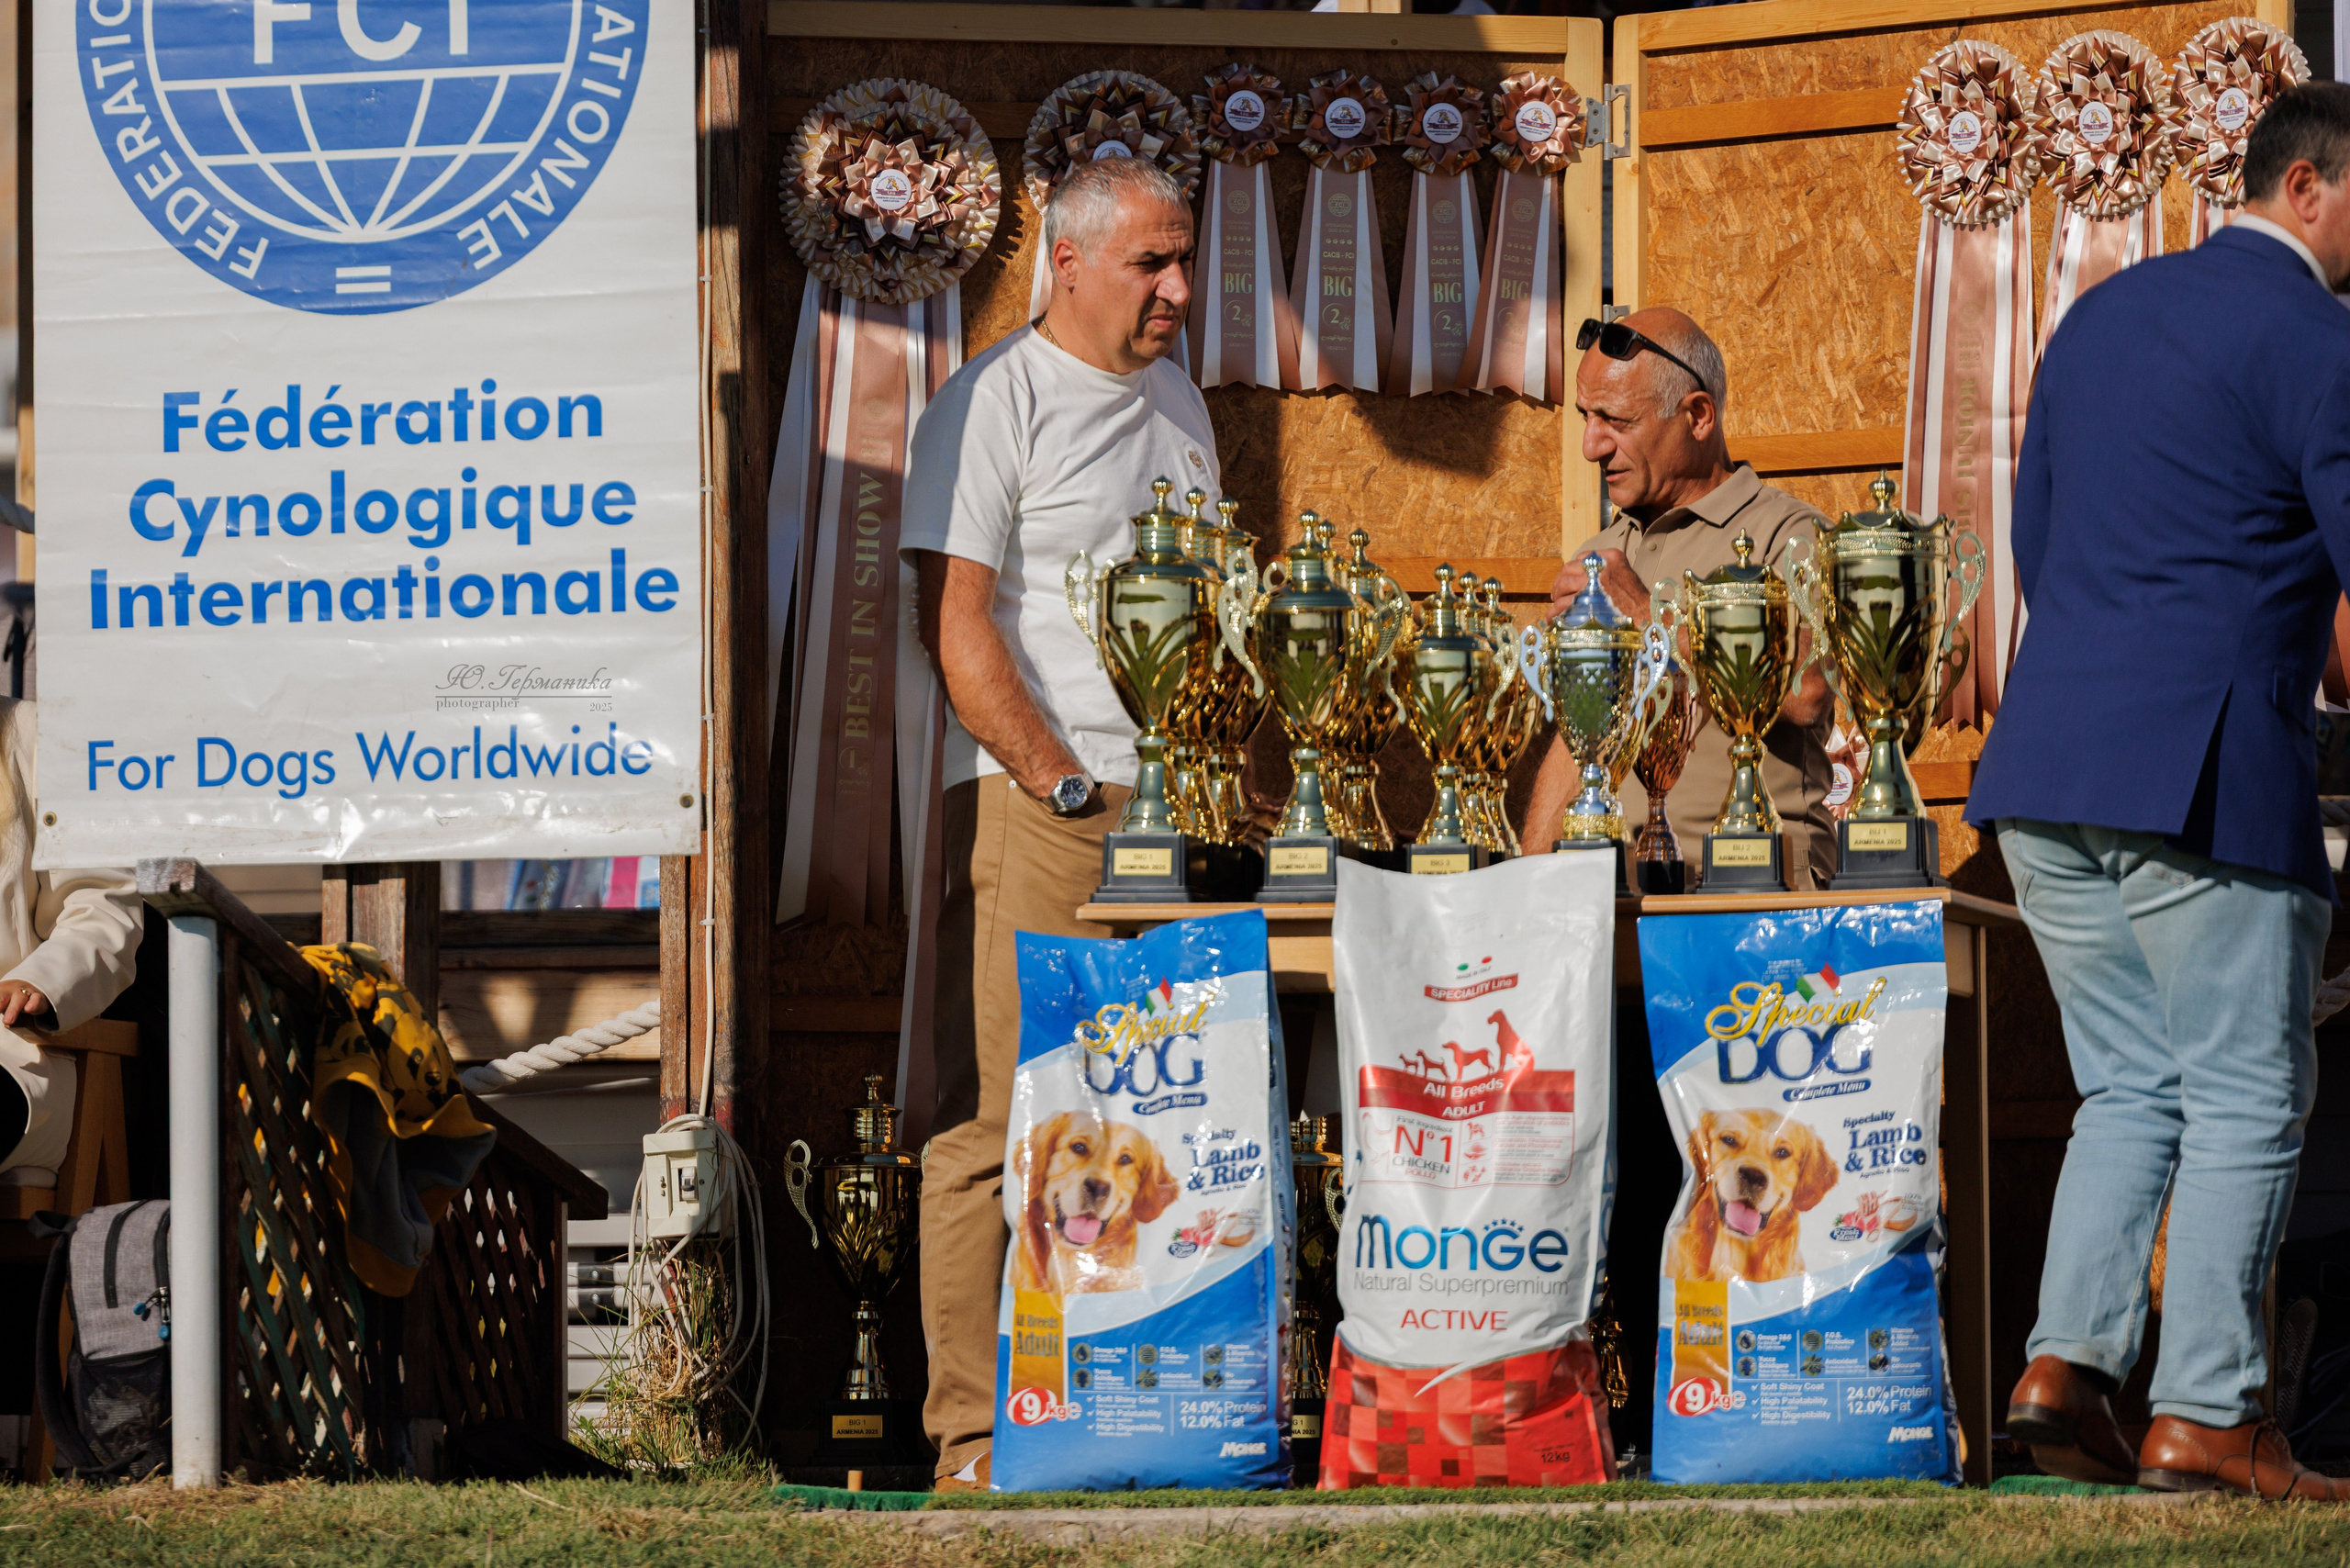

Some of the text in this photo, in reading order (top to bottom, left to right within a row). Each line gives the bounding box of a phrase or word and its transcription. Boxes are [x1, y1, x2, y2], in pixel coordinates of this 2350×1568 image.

[1323, 251, 1340, 259] CACIB
[1225, 273, 1253, 294] BIG
[1323, 275, 1352, 297] BIG
[1433, 282, 1462, 303] BIG
[1500, 278, 1529, 302] BIG
[1232, 306, 1241, 320] 2
[1330, 308, 1340, 324] 2
[1441, 315, 1451, 330] 2
[162, 378, 603, 453] Fédération
[1957, 379, 1975, 477] JUNIOR
[129, 466, 637, 557] Cynologique
[854, 470, 886, 588] SHOW
[92, 548, 679, 629] Internationale
[850, 599, 877, 637] IN
[845, 648, 875, 740] BEST
[87, 722, 655, 800] For Dogs Worldwide
[1431, 977, 1513, 1000] SPECIALITY Line
[1705, 977, 1887, 1047] Special
[1718, 1022, 1873, 1085] DOG
[1084, 1033, 1207, 1097] DOG
[1424, 1077, 1505, 1100] All Breeds
[1791, 1081, 1865, 1101] Complete Menu
[1396, 1114, 1415, 1124] First
[1442, 1101, 1486, 1118] ADULT
[1843, 1111, 1896, 1128] Specialty
[1849, 1123, 1922, 1150] Lamb
[1192, 1138, 1261, 1168] Lamb
[1439, 1134, 1453, 1163] 1
[1845, 1146, 1927, 1172] & Rice
[1210, 1163, 1265, 1186] Rice
[1393, 1155, 1451, 1175] CHICKEN
[1404, 1168, 1437, 1181] POLLO
[1353, 1271, 1570, 1297] Natural Superpremium
[1027, 1315, 1058, 1328] Breeds
[1399, 1308, 1508, 1331] ACTIVE
[1693, 1305, 1723, 1317] Breeds
[1014, 1331, 1059, 1357] Adult
[1678, 1320, 1724, 1346] Adult
[1684, 1383, 1706, 1413] 9
[1779, 1383, 1802, 1392] Shiny
[1804, 1383, 1825, 1391] Coat
[1847, 1385, 1932, 1401] 24.0% Protein
[1021, 1392, 1041, 1420] 9
[1096, 1395, 1159, 1405] Soft Shiny Coat
[1180, 1401, 1267, 1415] 24.0% Protein
[1761, 1396, 1828, 1406] High Palatability
[1847, 1400, 1912, 1415] 12.0% Fat
[1096, 1409, 1162, 1418] High Palatability
[1180, 1415, 1245, 1428] 12.0% Fat
[1761, 1411, 1831, 1420] High Digestibility
[1096, 1424, 1165, 1433] High Digestibility
